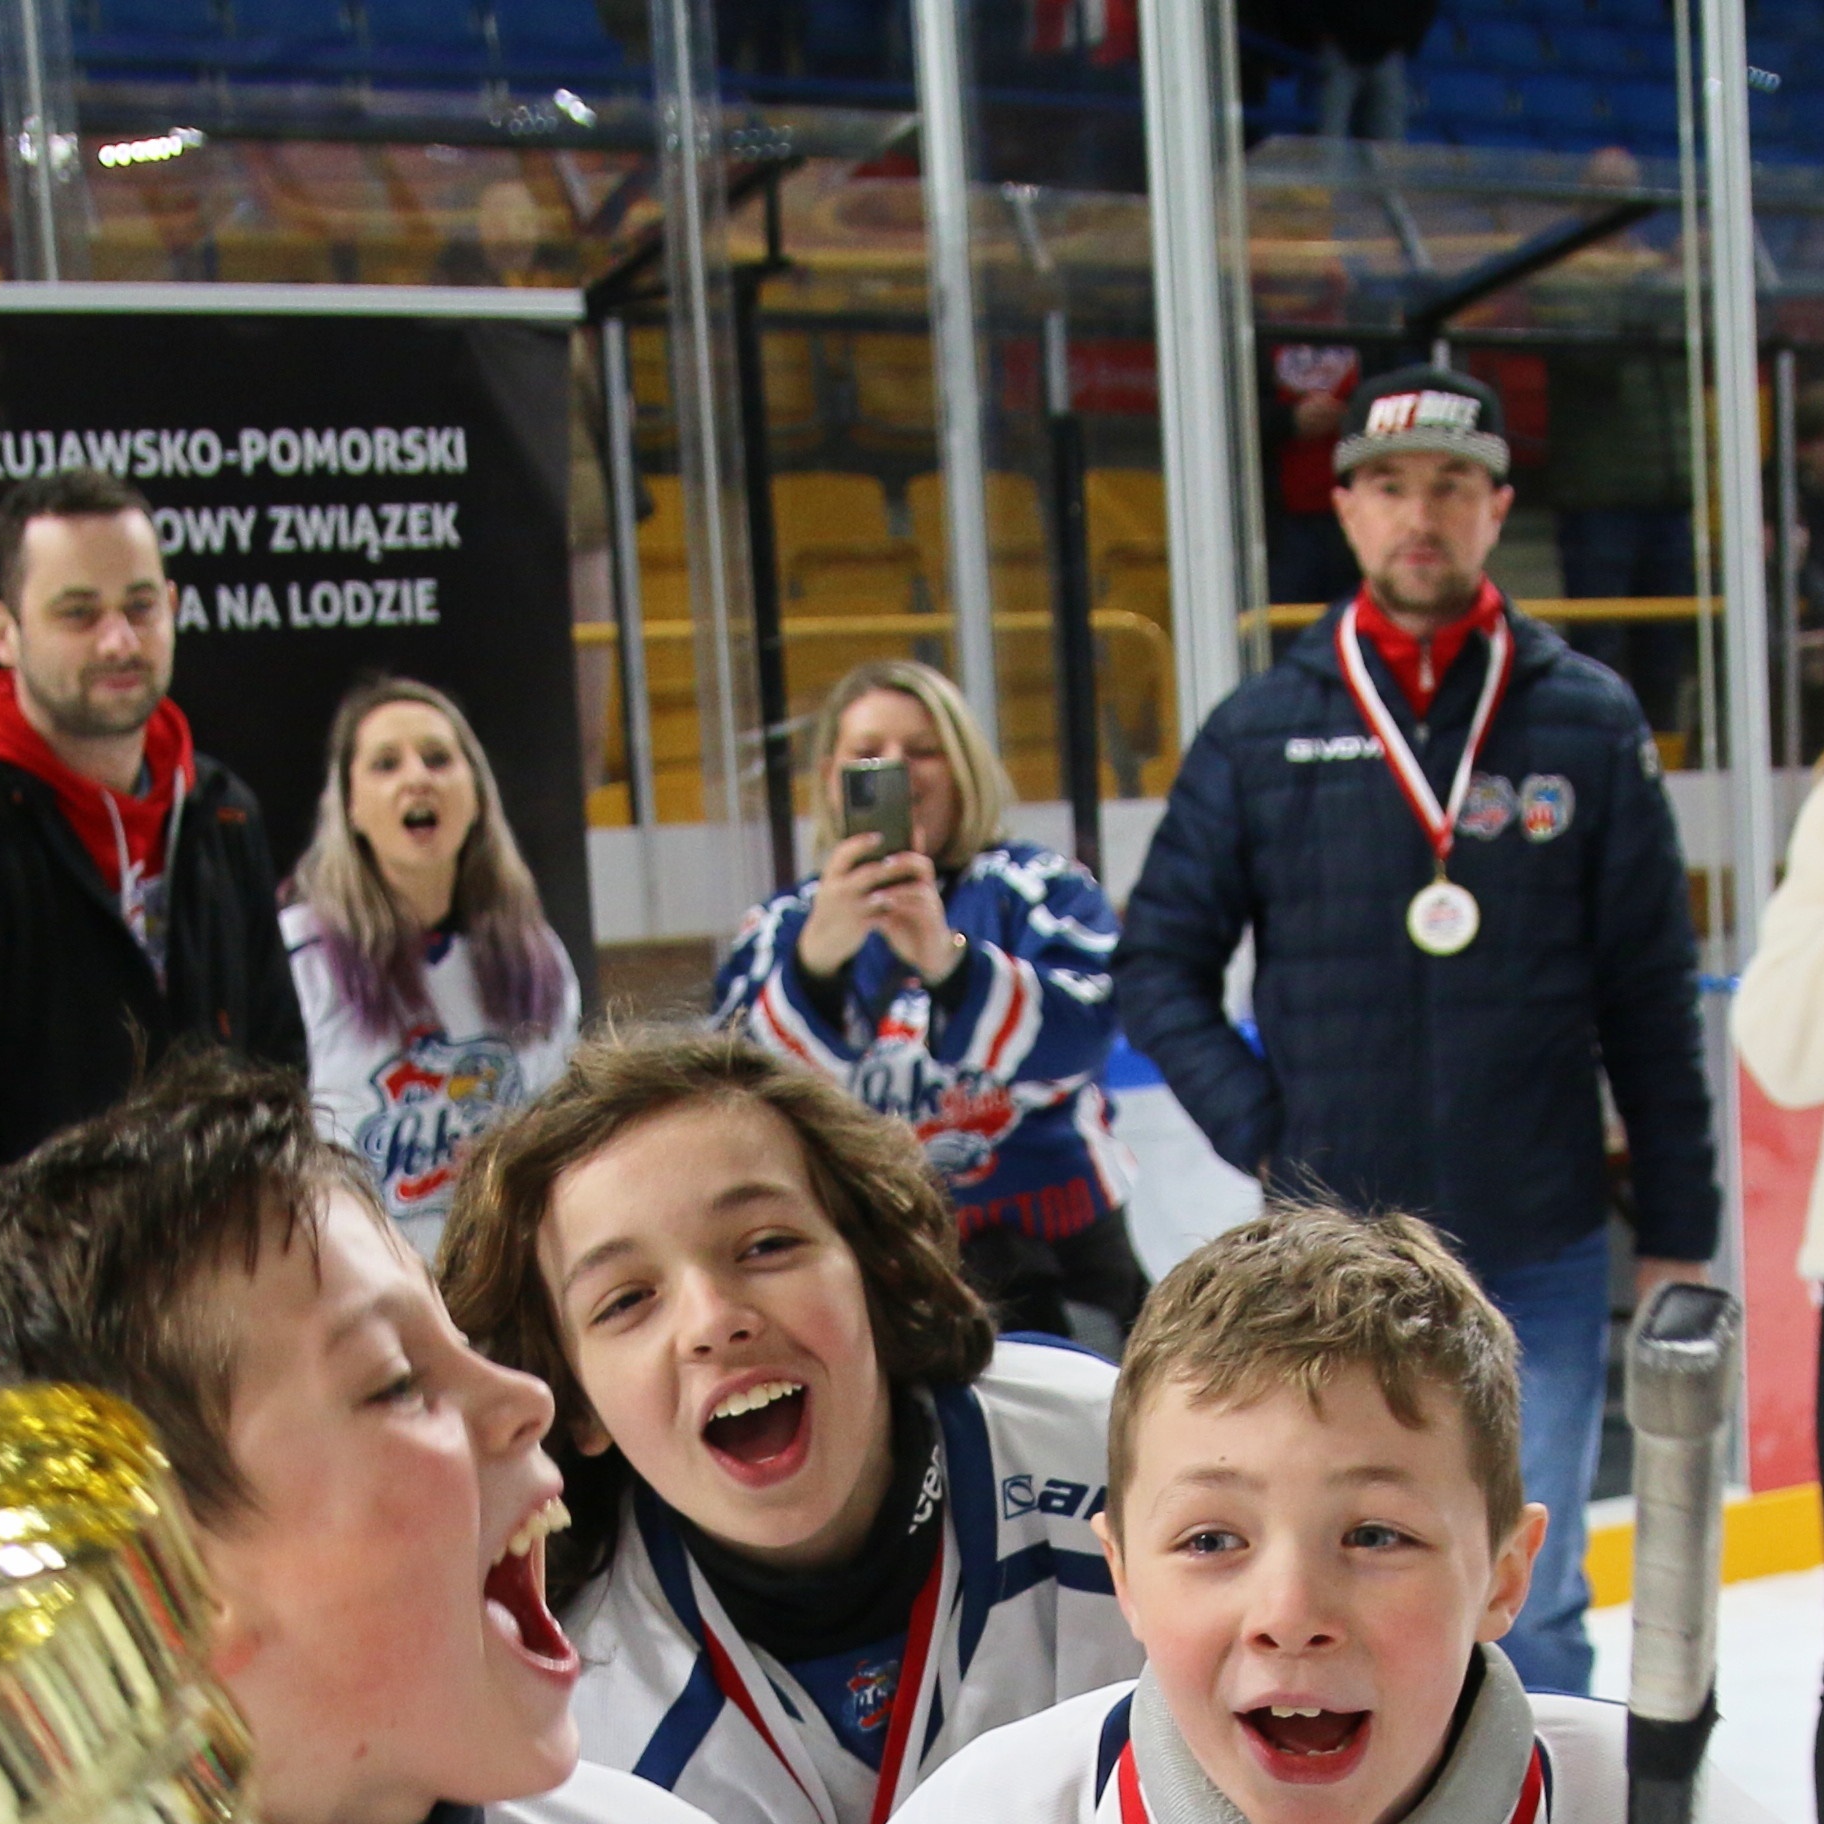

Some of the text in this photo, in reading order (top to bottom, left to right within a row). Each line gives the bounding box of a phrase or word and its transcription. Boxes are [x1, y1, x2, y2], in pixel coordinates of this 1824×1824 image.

[267, 502, 462, 563] ZWIĄZEK
[215, 583, 280, 632] NA
[287, 578, 440, 628] LODZIE
